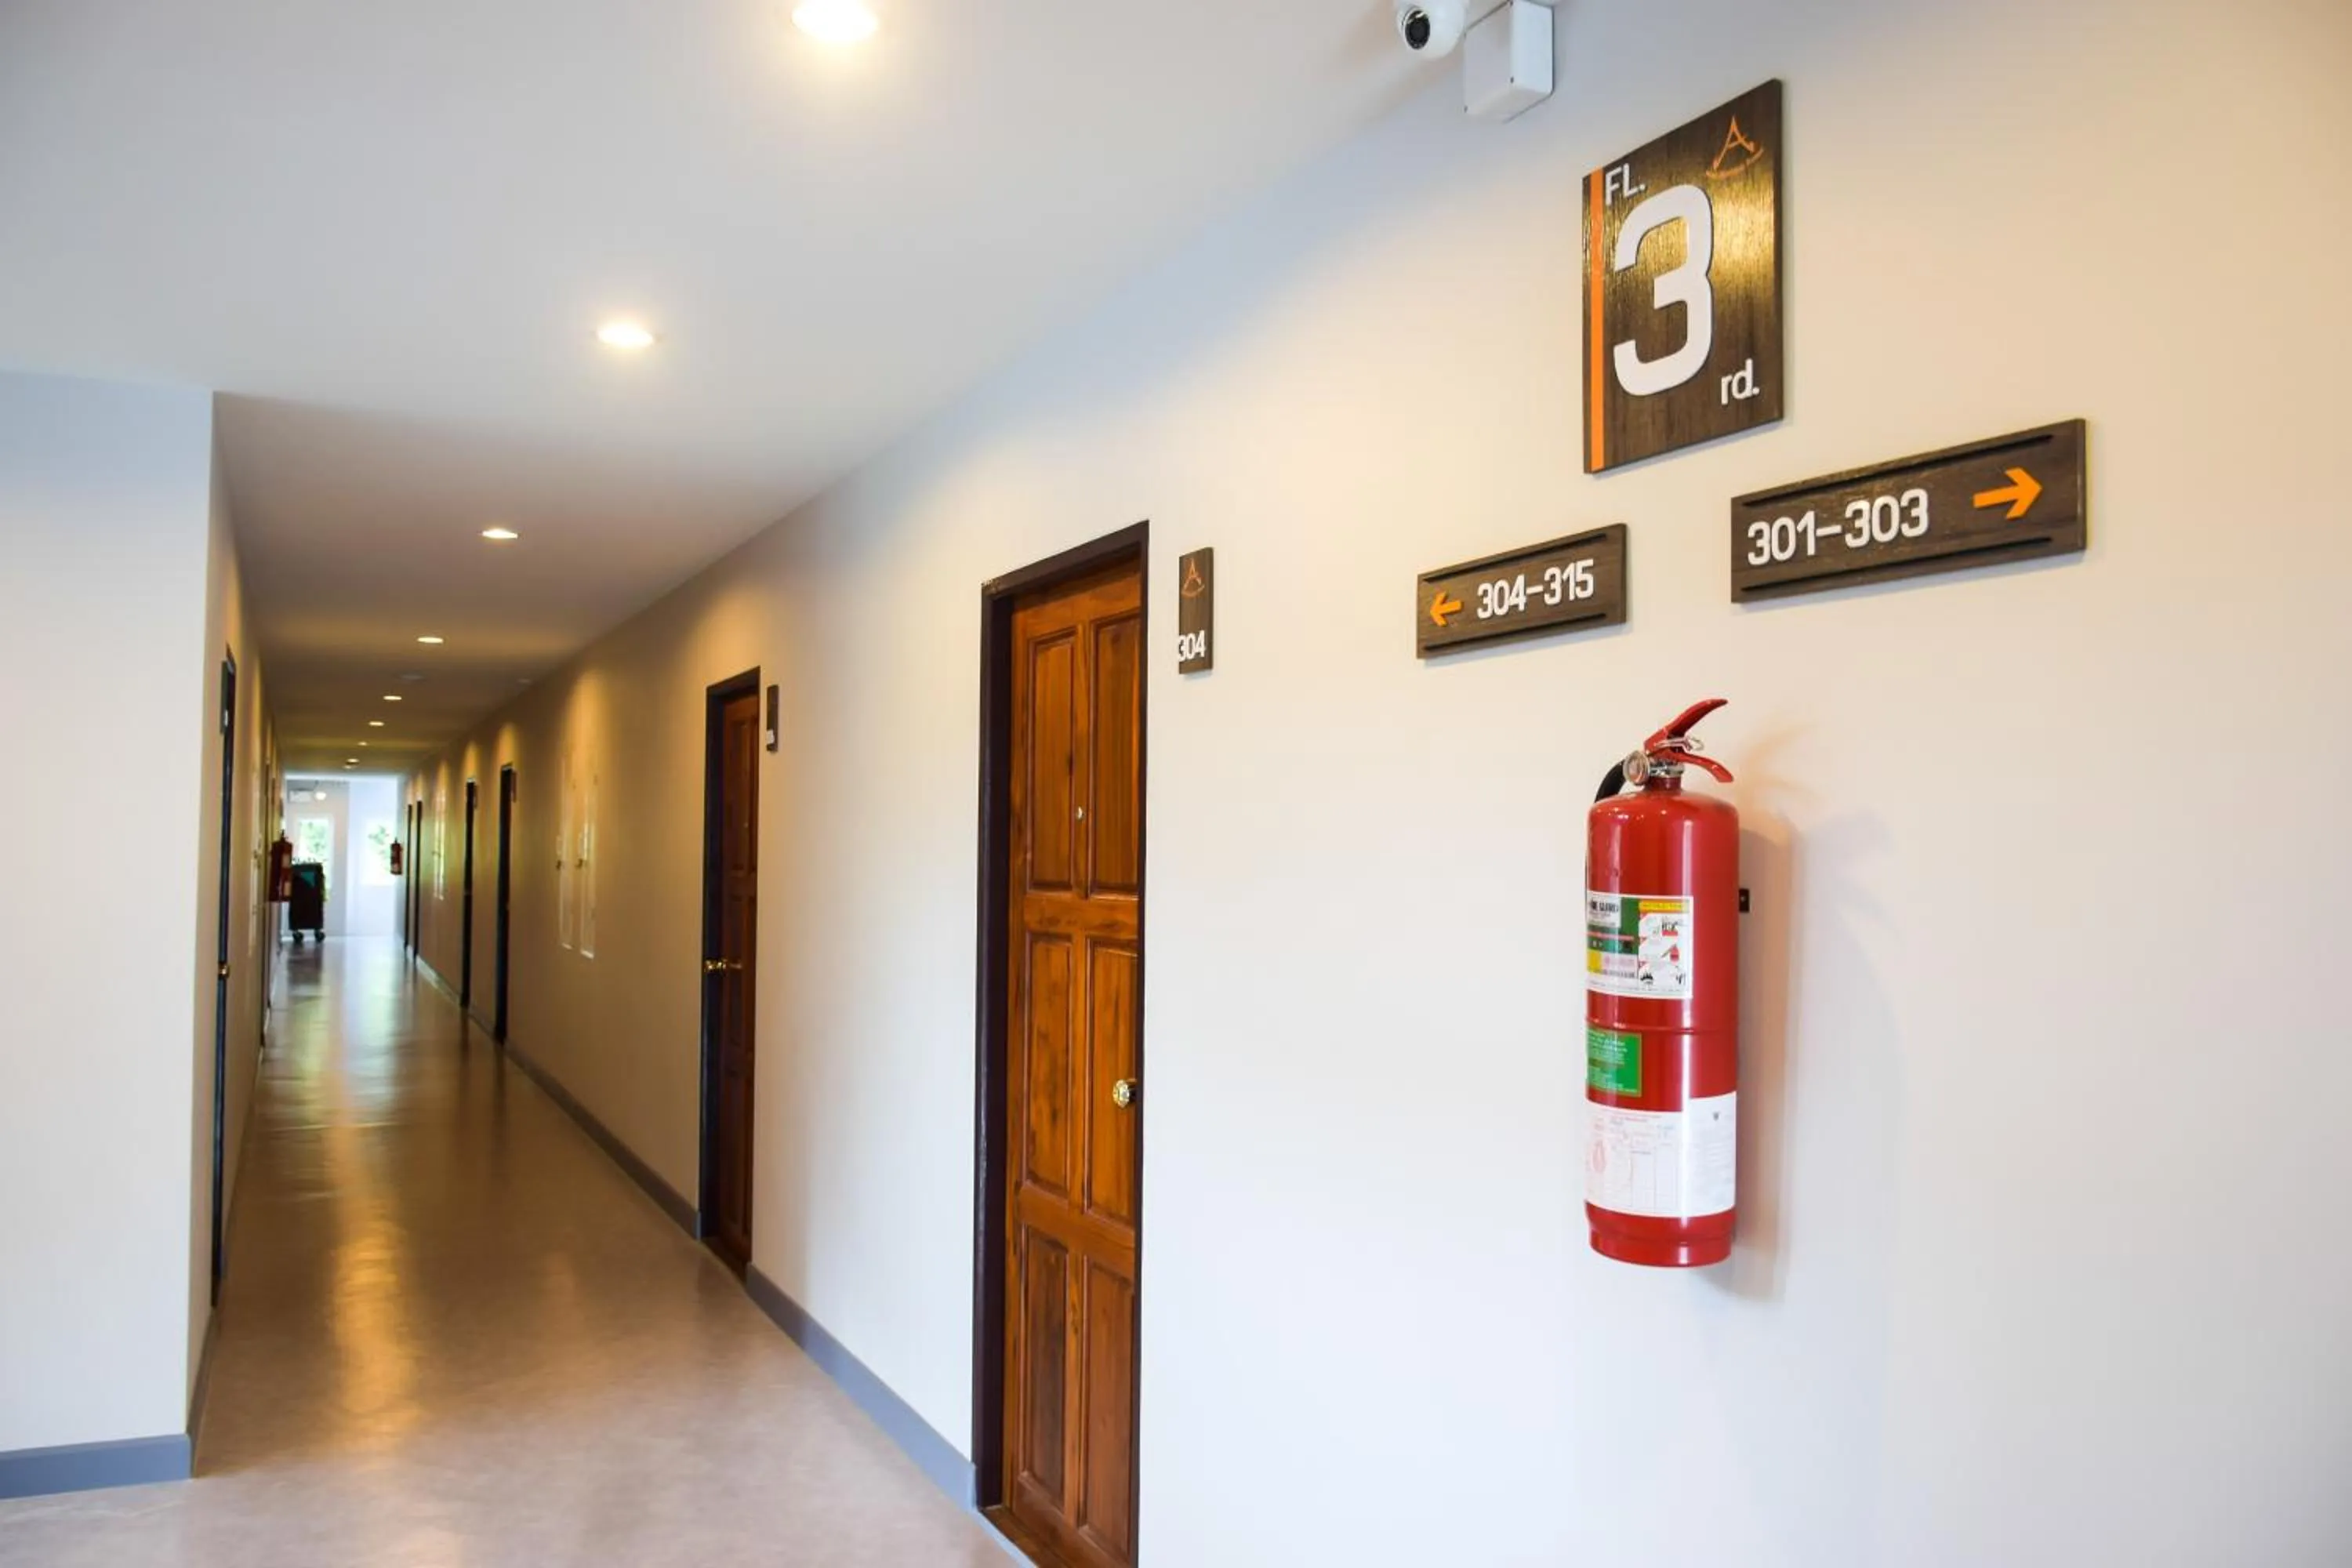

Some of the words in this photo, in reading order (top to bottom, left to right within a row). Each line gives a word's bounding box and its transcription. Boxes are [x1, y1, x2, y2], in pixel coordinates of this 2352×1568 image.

[1604, 162, 1646, 206] FL.
[1613, 183, 1715, 397] 3
[1720, 358, 1761, 406] rd.
[1747, 487, 1929, 566] 301-303
[1476, 558, 1595, 619] 304-315
[1178, 630, 1207, 662] 304
